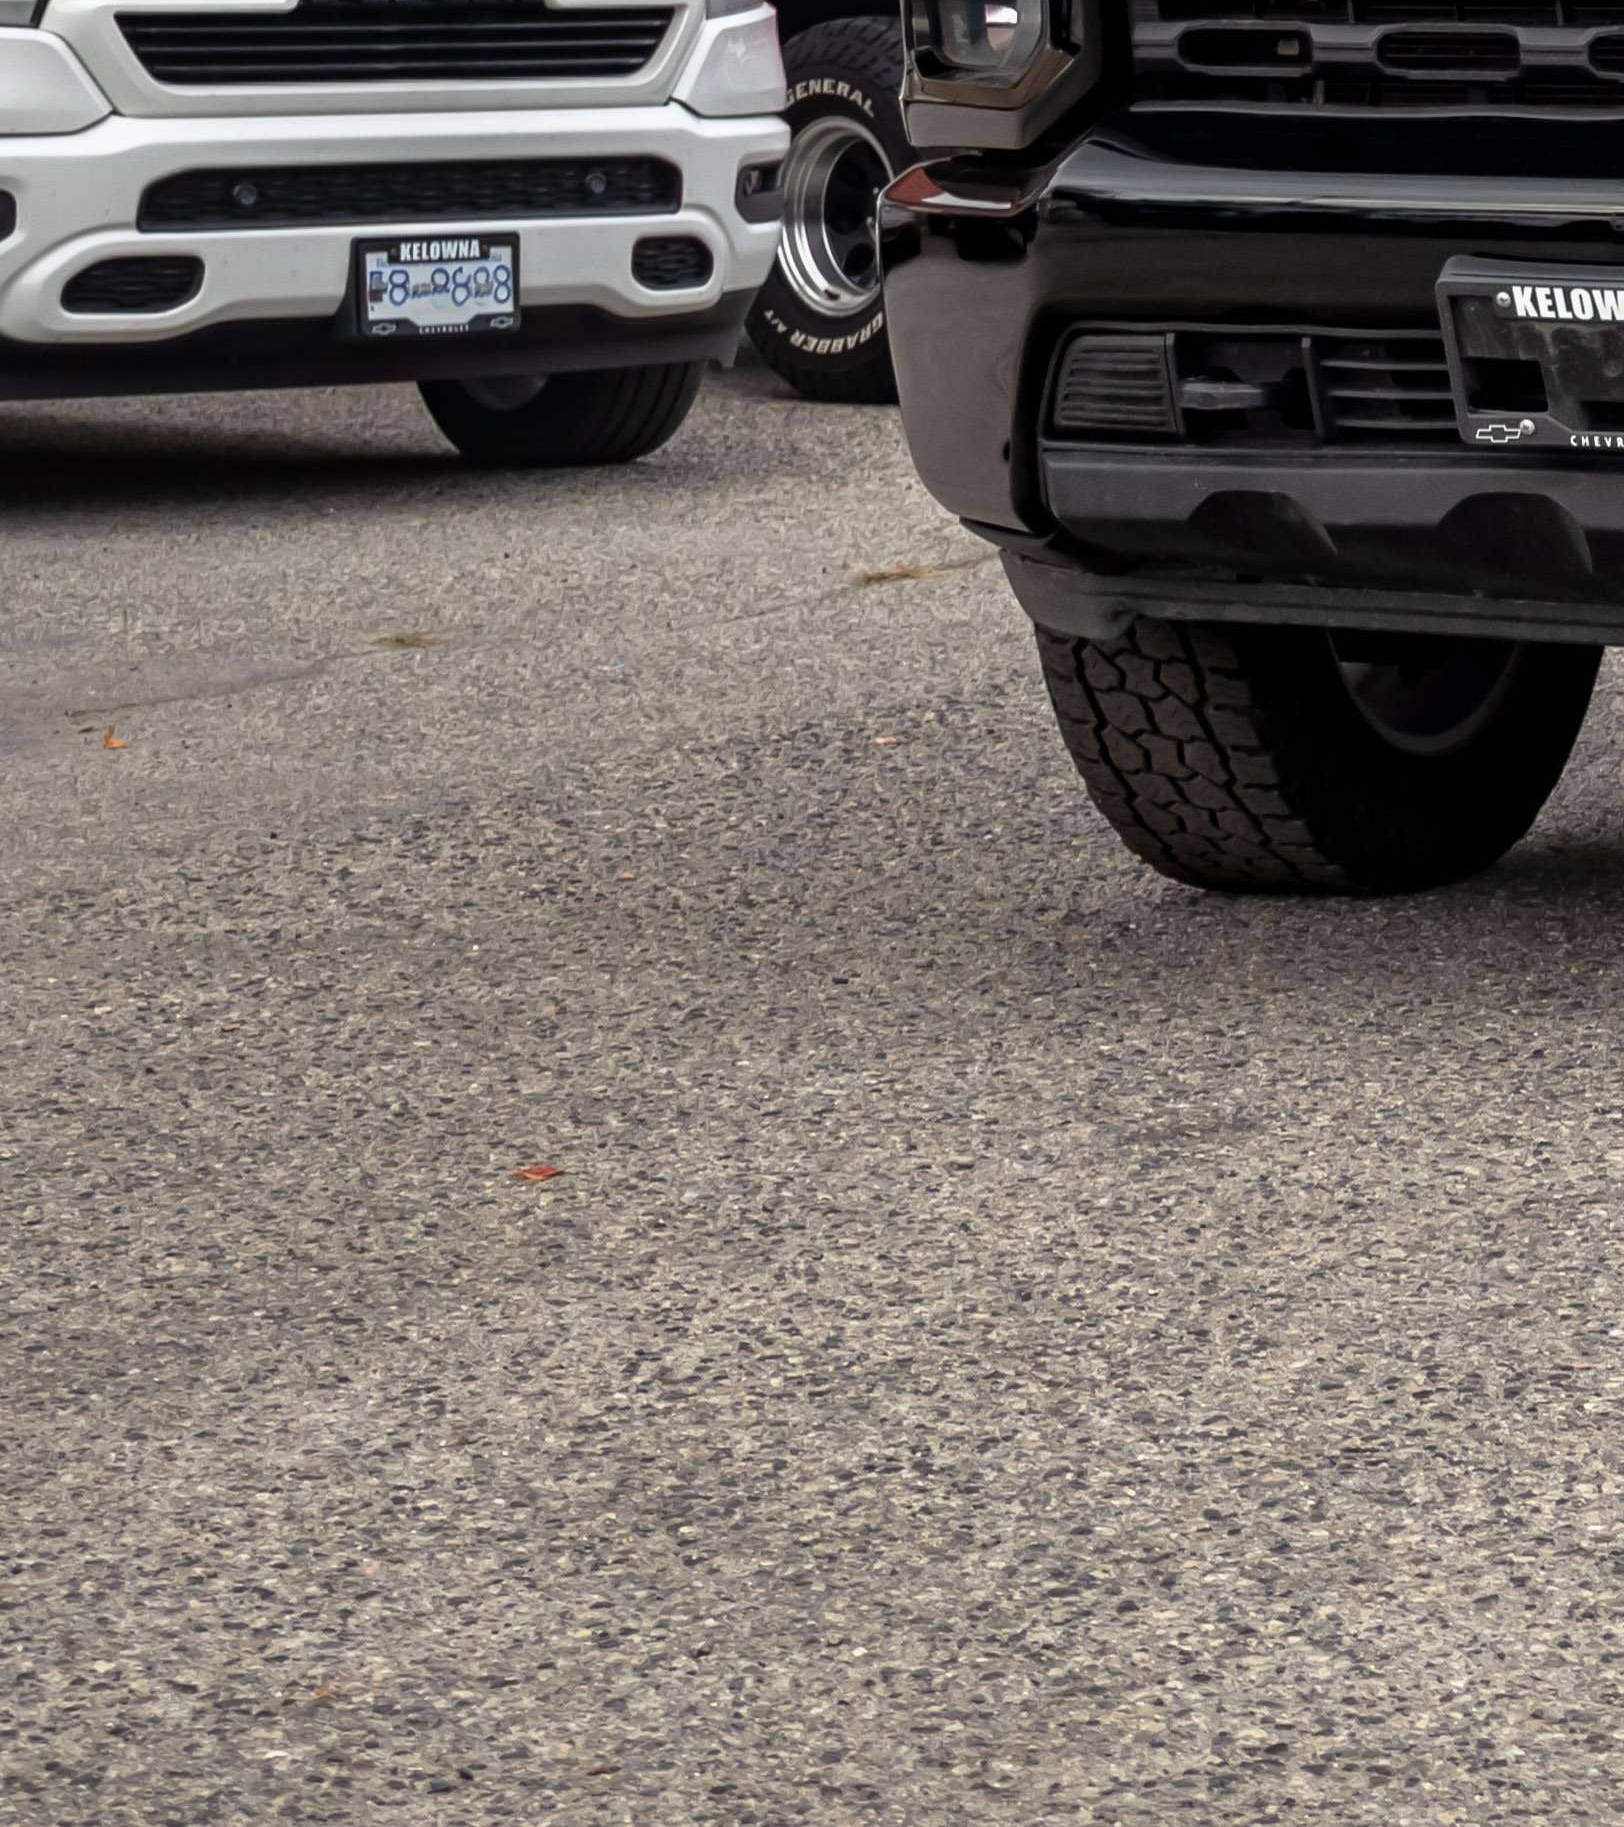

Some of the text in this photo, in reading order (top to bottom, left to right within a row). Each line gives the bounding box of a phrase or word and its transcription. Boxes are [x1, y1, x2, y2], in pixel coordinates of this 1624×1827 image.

[786, 77, 875, 118] GENERAL
[400, 238, 480, 261] KELOWNA
[789, 311, 884, 354] GRABBER
